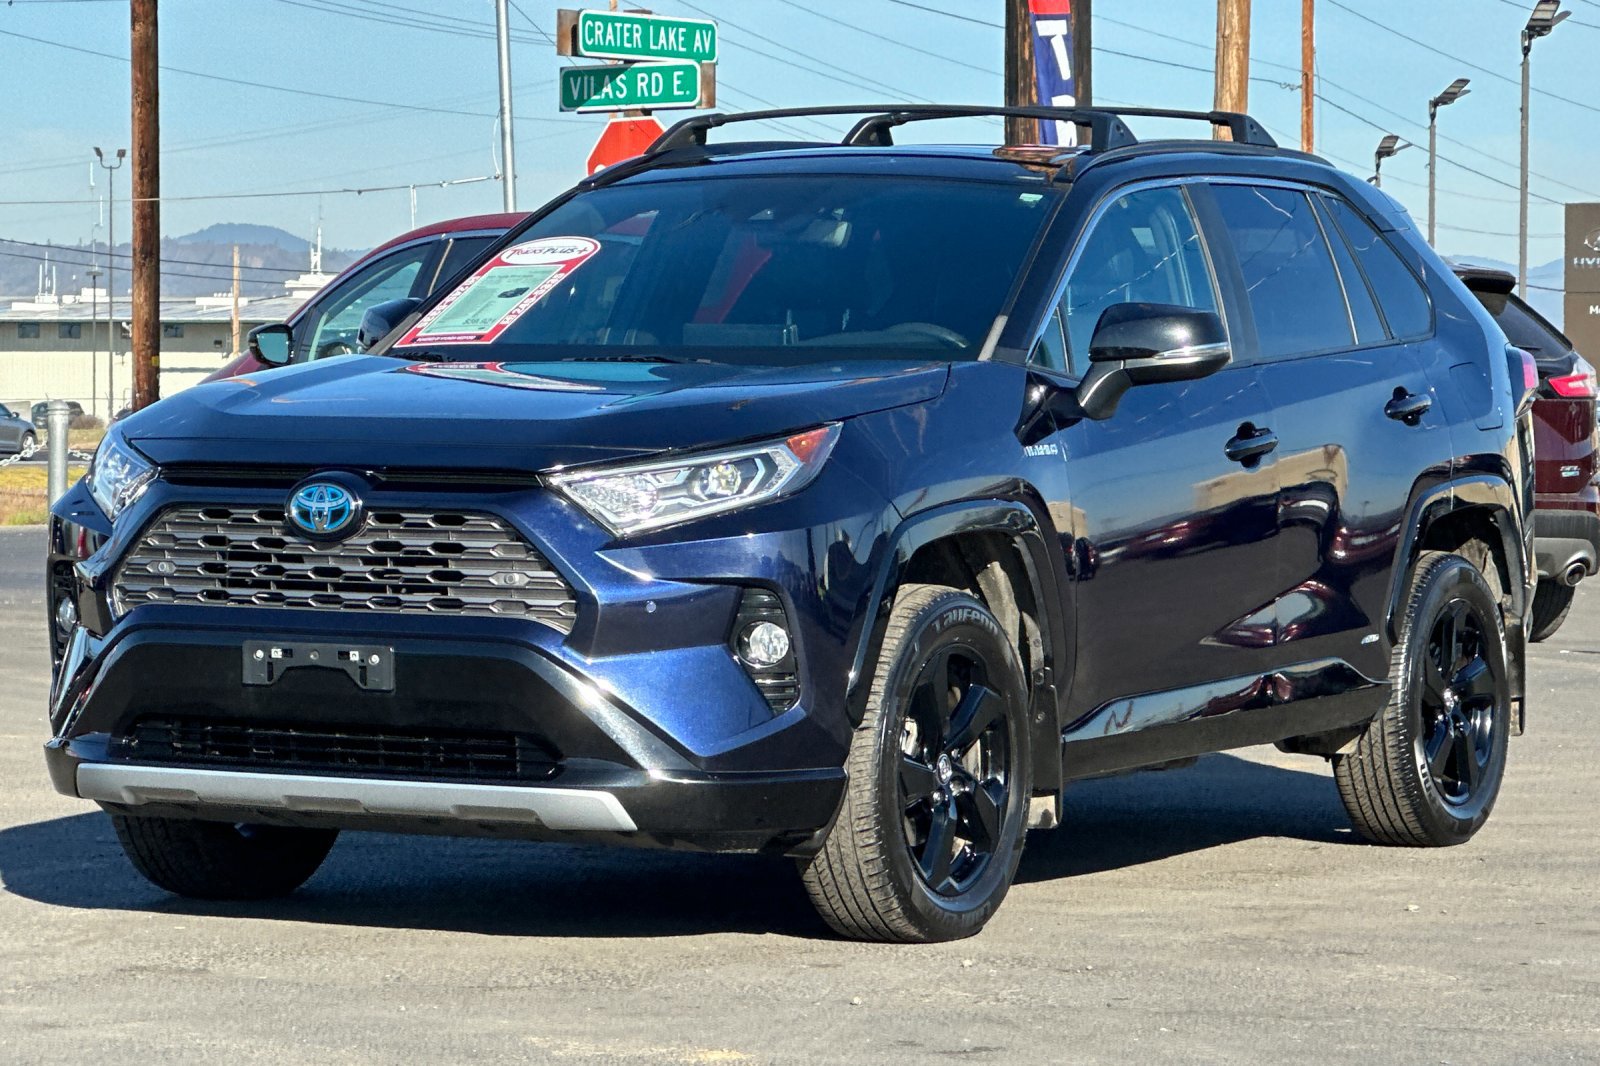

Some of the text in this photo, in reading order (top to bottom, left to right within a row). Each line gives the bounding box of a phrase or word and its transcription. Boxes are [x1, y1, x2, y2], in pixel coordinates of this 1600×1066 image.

[584, 20, 712, 54] CRATER LAKE AV
[569, 71, 691, 101] VILAS RD E.
